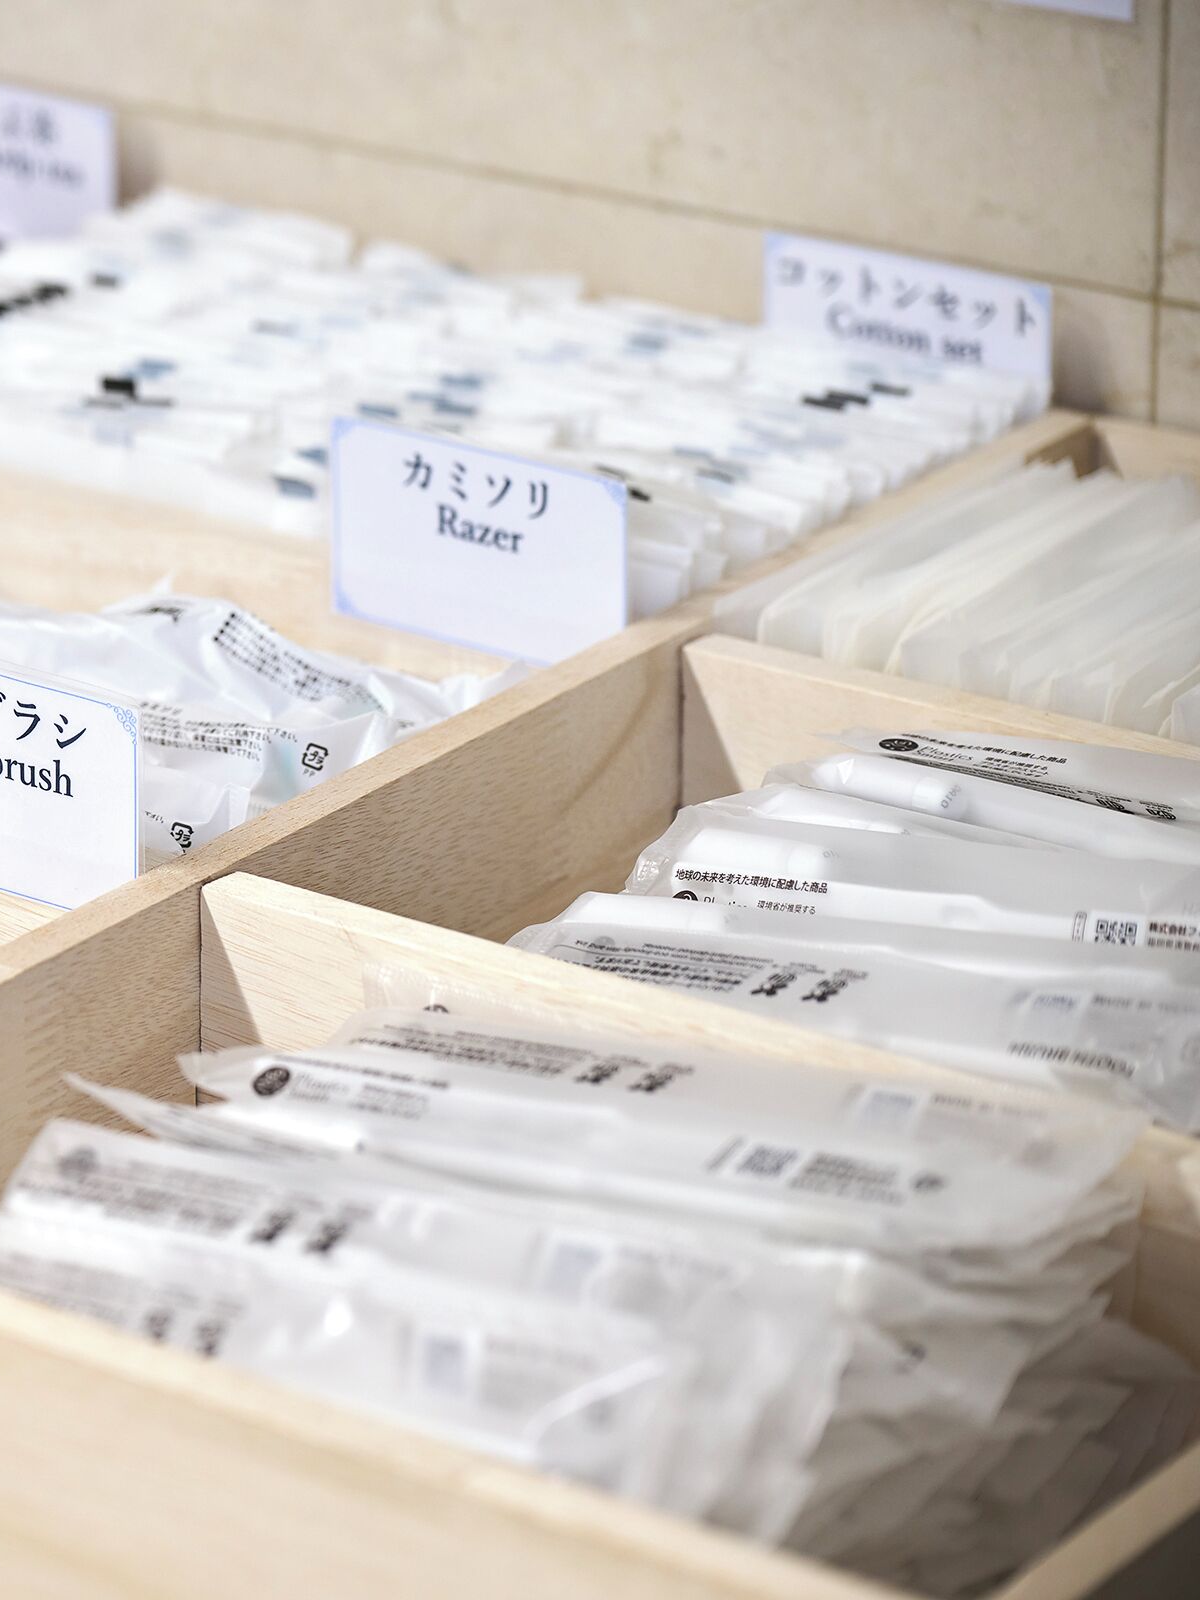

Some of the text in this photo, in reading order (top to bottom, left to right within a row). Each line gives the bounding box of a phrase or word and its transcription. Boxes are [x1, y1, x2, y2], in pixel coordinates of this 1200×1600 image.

[777, 256, 1035, 337] コットンセット
[826, 301, 981, 363] Cotton set
[404, 452, 548, 520] カミソリ
[436, 502, 523, 553] Razer
[919, 745, 975, 762] Plastics
[674, 868, 828, 894] 地球の未来を考えた環境に配慮した商品
[756, 899, 816, 916] 環境省が推奨する
